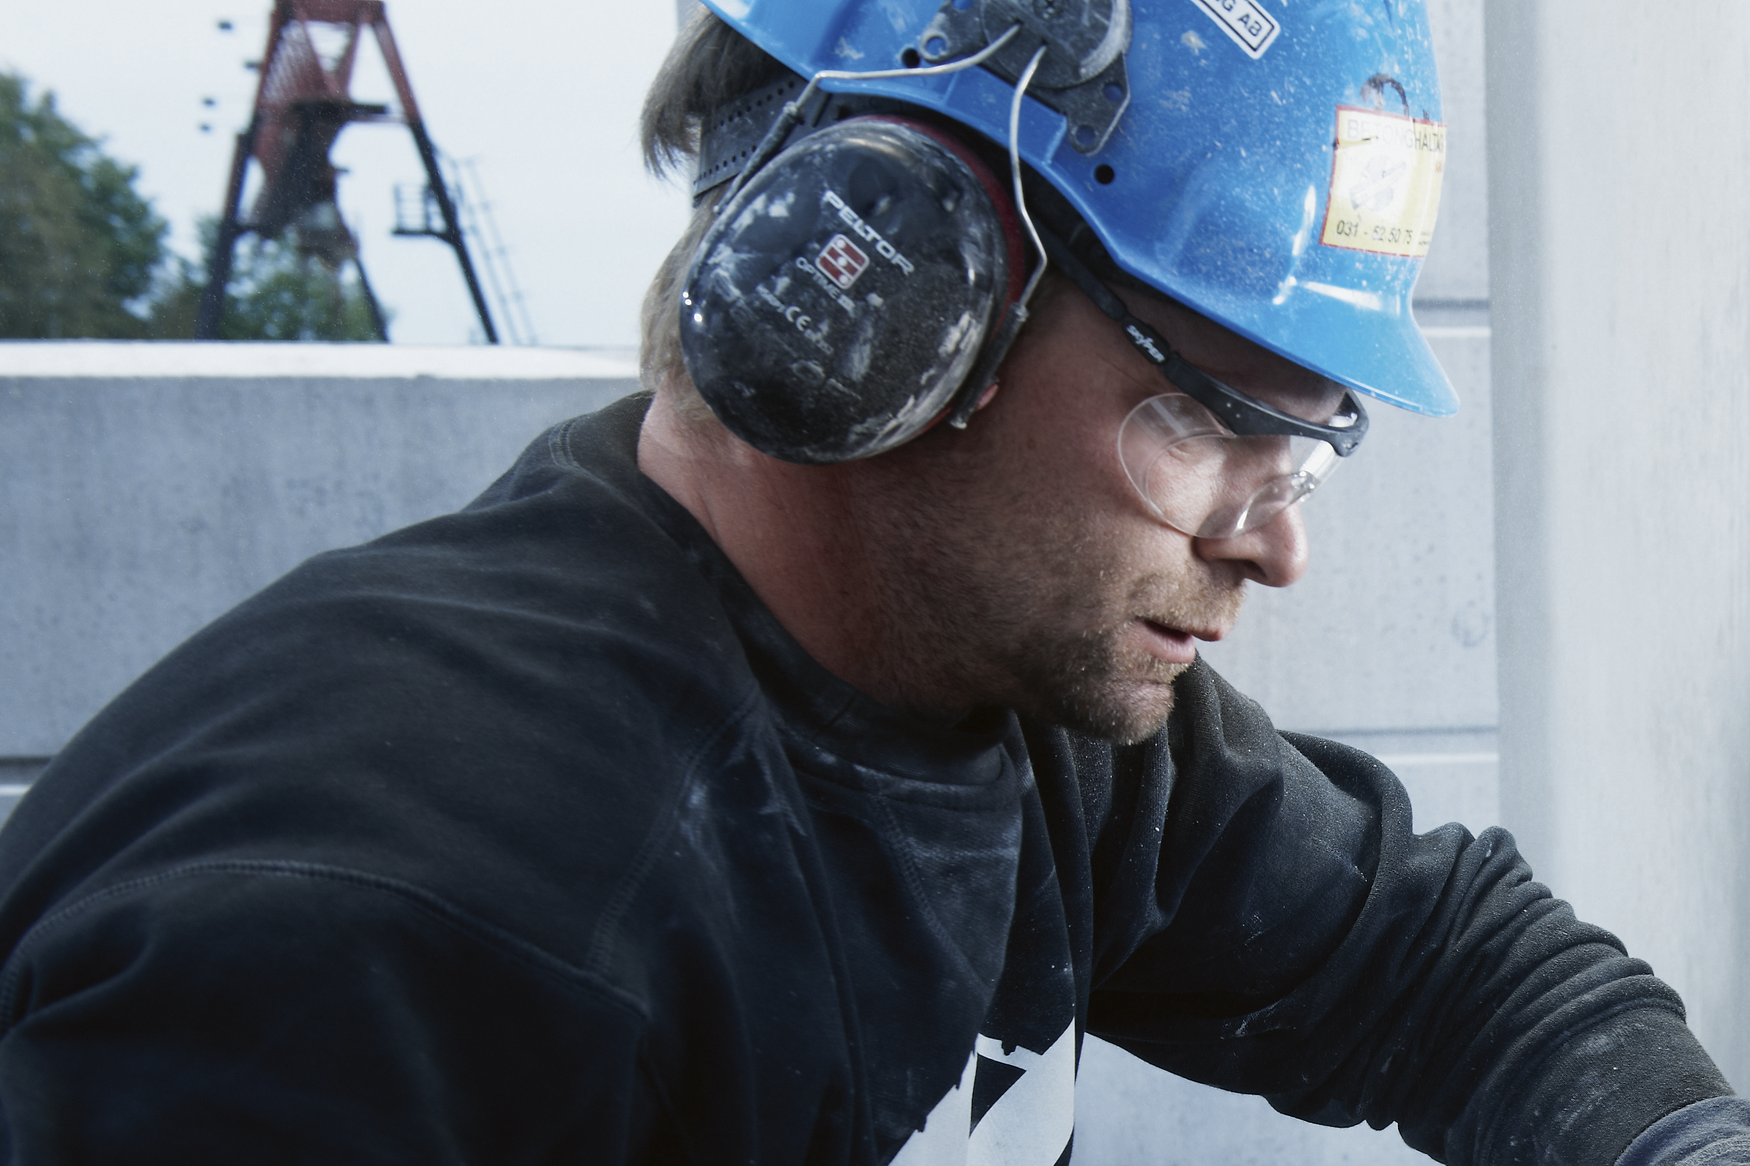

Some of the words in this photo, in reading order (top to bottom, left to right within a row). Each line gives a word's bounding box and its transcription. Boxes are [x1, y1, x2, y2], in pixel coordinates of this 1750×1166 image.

[1237, 13, 1262, 37] AB
[821, 189, 915, 276] PELTOR
[1336, 220, 1359, 238] 031
[795, 257, 841, 299] OPTIME
